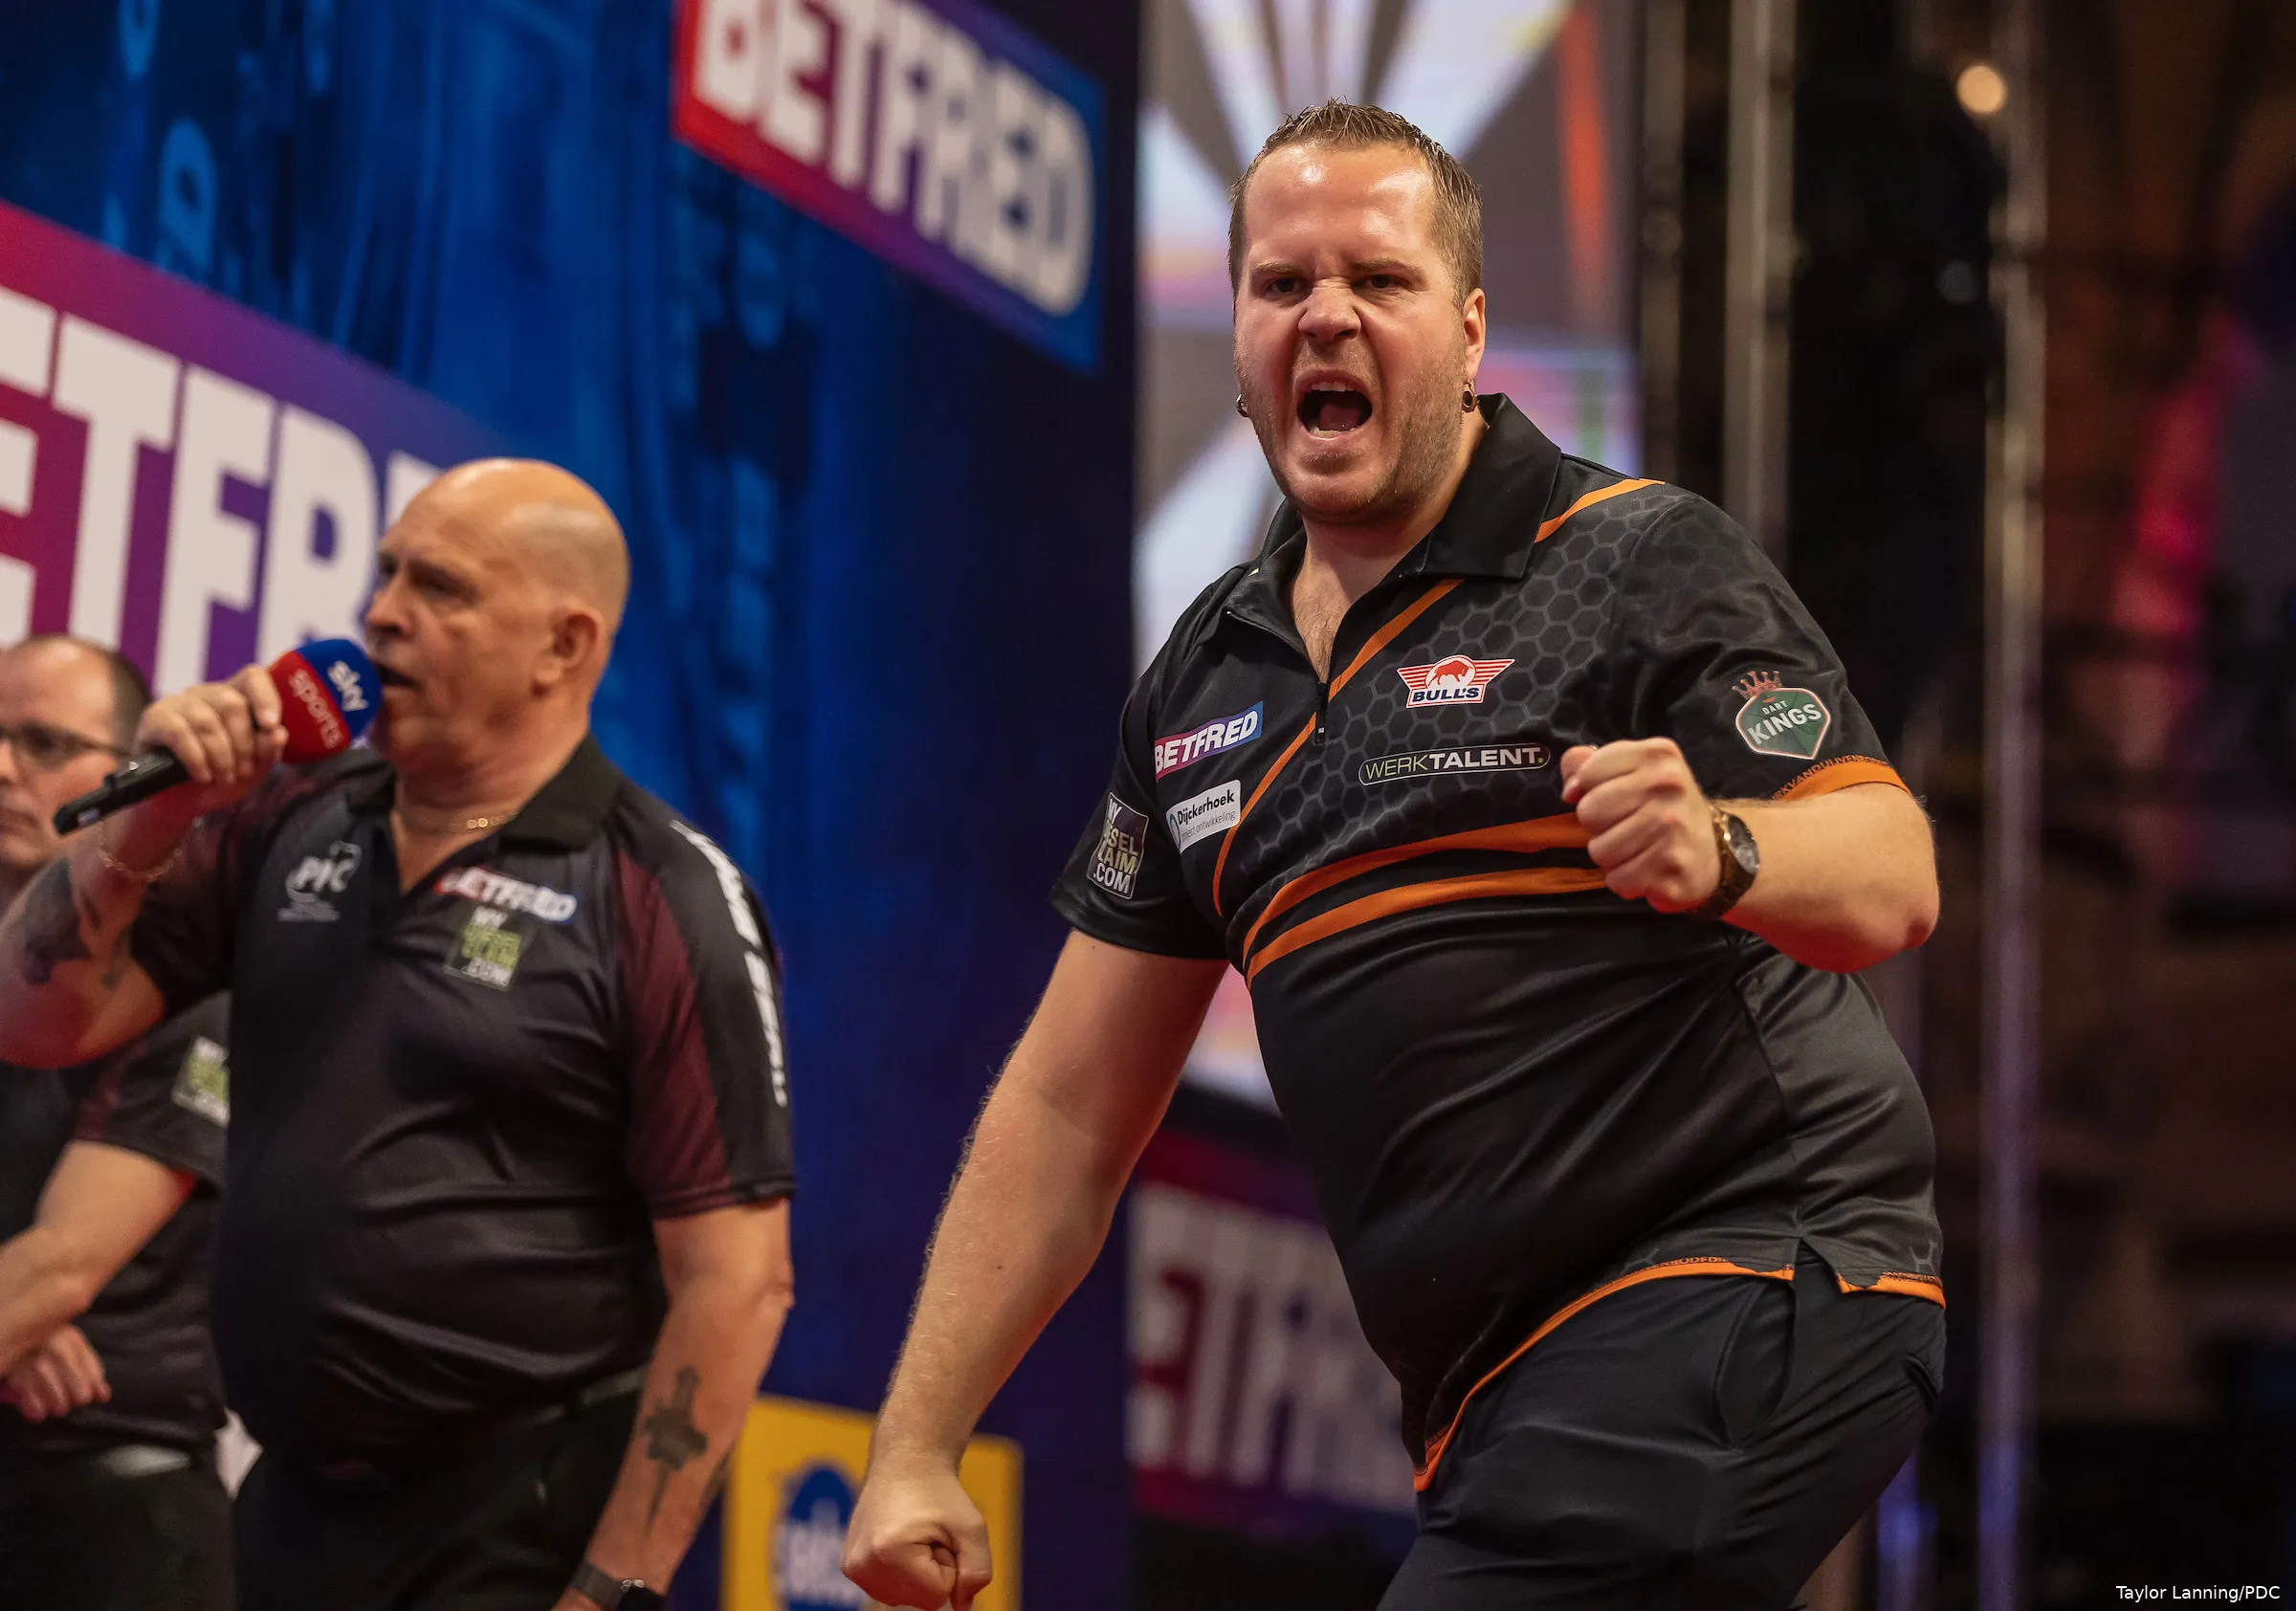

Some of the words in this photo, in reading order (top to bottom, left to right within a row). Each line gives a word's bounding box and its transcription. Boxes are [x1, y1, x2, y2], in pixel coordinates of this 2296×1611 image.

[326, 660, 369, 712] sky
[1412, 687, 1480, 702] BULL'S
[1747, 703, 1821, 745] KINGS
[1761, 700, 1788, 716] DART
[1154, 710, 1258, 774] BETFRED
[1177, 789, 1235, 826] Dijckerhoek
[1093, 863, 1132, 894] .COM
